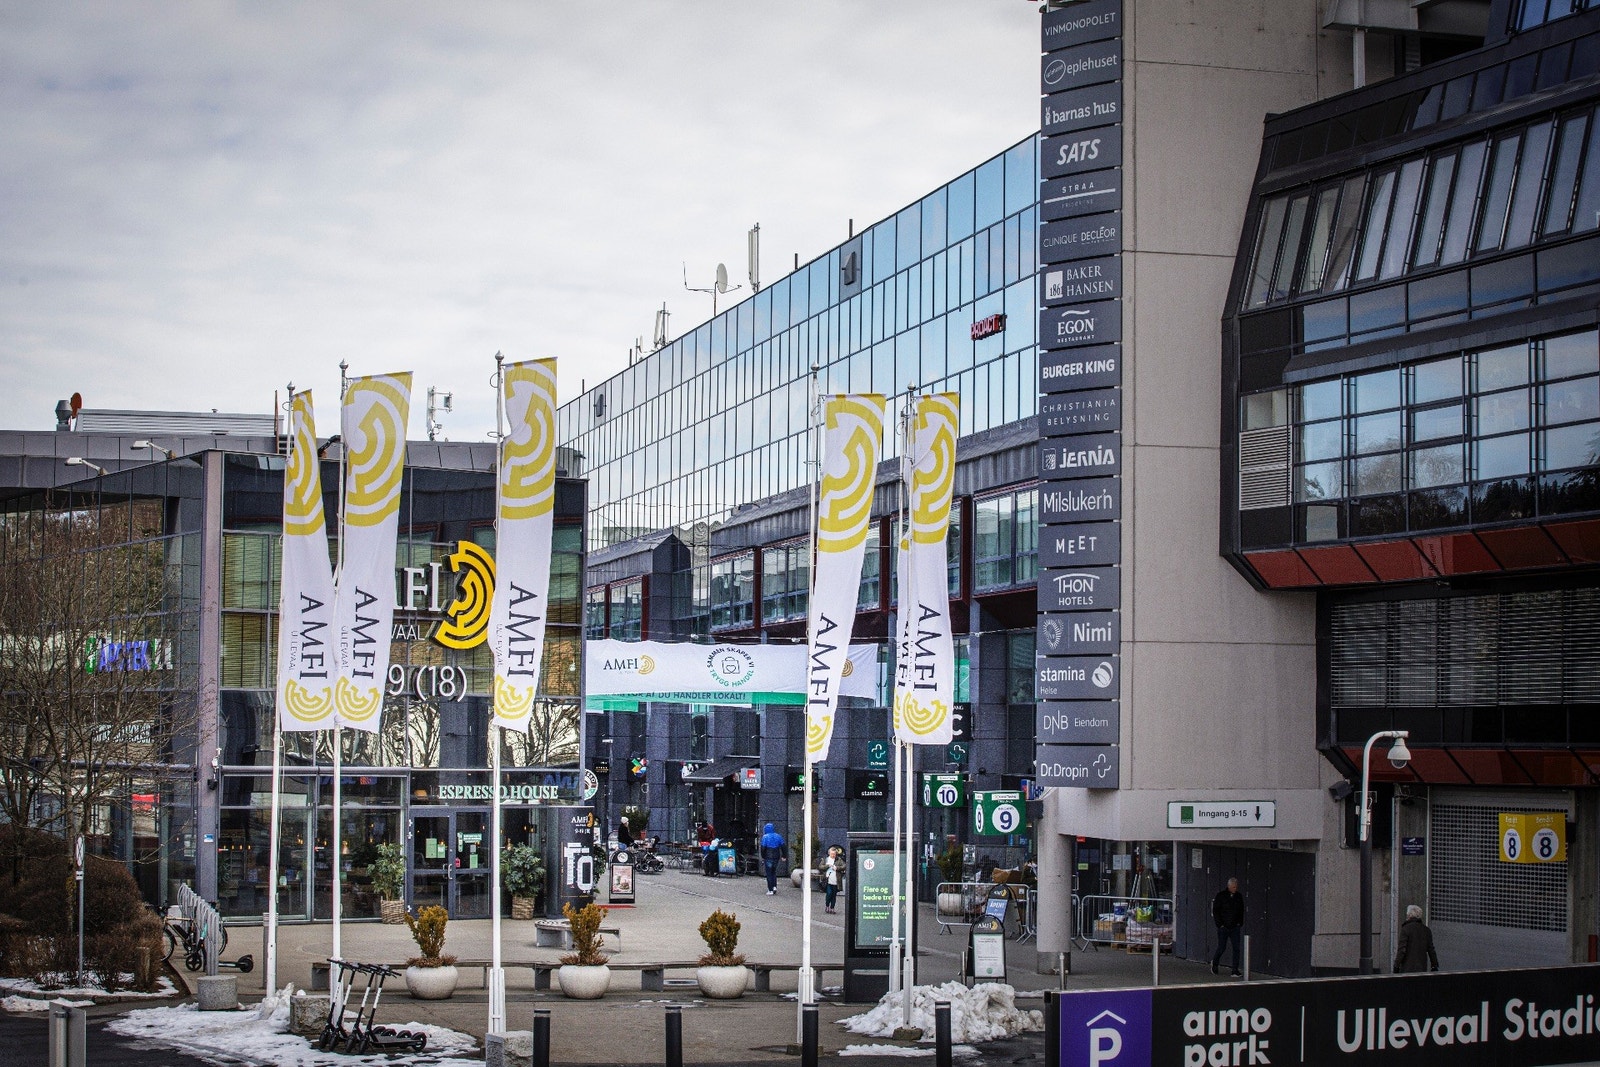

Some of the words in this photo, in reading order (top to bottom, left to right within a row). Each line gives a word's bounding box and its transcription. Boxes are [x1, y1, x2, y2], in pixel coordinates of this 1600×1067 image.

[1044, 12, 1116, 36] VINMONOPOLET
[1066, 54, 1118, 76] eplehuset
[1052, 105, 1091, 124] barnas
[1093, 102, 1116, 116] hus
[1057, 138, 1101, 165] SATS
[1061, 181, 1094, 193] STRAA
[1043, 233, 1077, 247] CLINIQUE
[1081, 226, 1116, 242] DECLÉOR
[1066, 265, 1102, 281] BAKER
[1066, 280, 1114, 297] HANSEN
[1057, 318, 1095, 336] EGON
[1042, 362, 1083, 379] BURGER
[1085, 359, 1115, 374] KING
[1042, 399, 1116, 413] CHRISTIANIA
[1047, 413, 1109, 426] BELYSNING
[1056, 535, 1097, 554] MEET
[1055, 575, 1097, 593] THON
[1058, 596, 1094, 606] HOTELS
[300, 592, 328, 679] AMFI
[351, 586, 380, 679] AMFI
[505, 581, 540, 678] AMFI
[1073, 621, 1112, 642] Nimi
[914, 600, 942, 691] AMFI
[603, 658, 639, 670] AMFI
[706, 647, 725, 668] SAMMEN
[726, 647, 752, 661] SKAPER
[809, 612, 838, 708] AMFI
[416, 665, 467, 702] (18)
[709, 669, 729, 687] TRYGG
[731, 670, 755, 687] HANDEL
[1040, 666, 1085, 682] stamina
[673, 691, 711, 700] HANDLER
[713, 691, 746, 700] LOKALT!
[1040, 686, 1057, 695] Helse
[1043, 709, 1069, 735] DNB
[1074, 717, 1109, 727] Eiendom
[1040, 763, 1089, 780] Dr.Dropin
[439, 785, 508, 799] ESPRESSO
[510, 785, 559, 799] HOUSE
[939, 789, 956, 804] 10
[977, 811, 982, 830] 9
[999, 810, 1013, 830] 9
[1198, 810, 1230, 819] Inngang
[1508, 837, 1517, 858] 8
[1539, 837, 1552, 858] 8
[1183, 1007, 1272, 1037] aimo
[1337, 1001, 1489, 1053] Ullevaal
[1503, 994, 1600, 1041] Stadi
[1089, 1027, 1122, 1067] P
[1184, 1034, 1272, 1067] park
